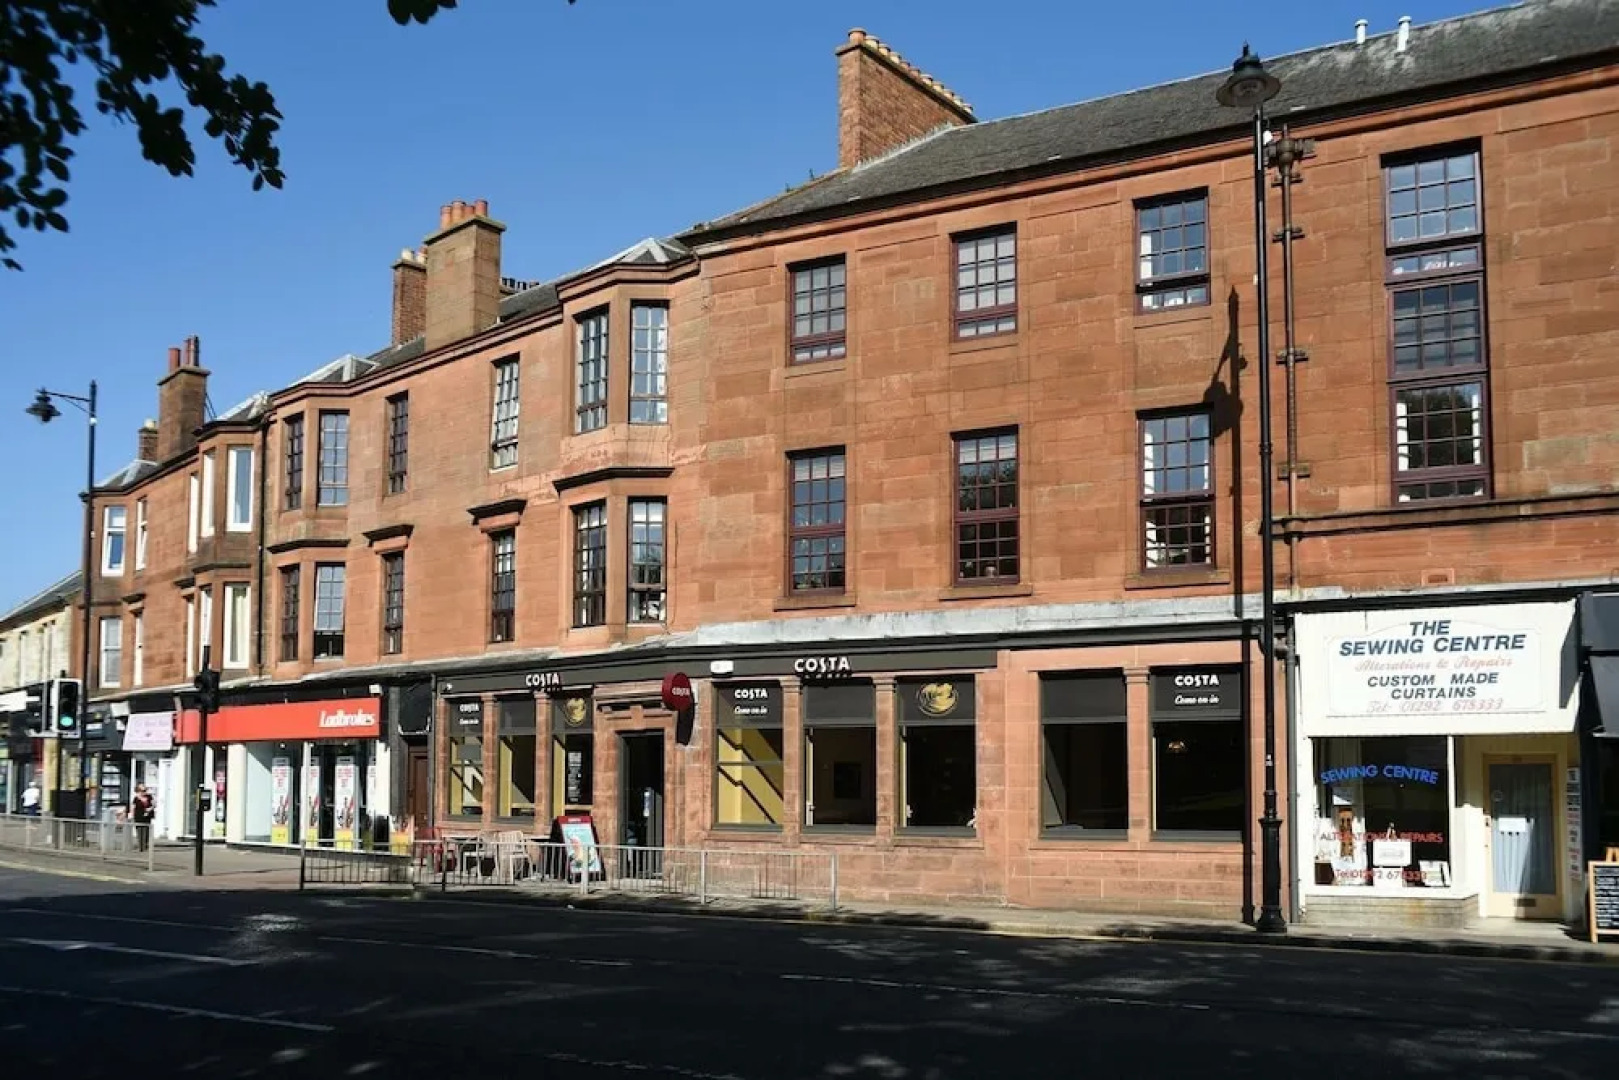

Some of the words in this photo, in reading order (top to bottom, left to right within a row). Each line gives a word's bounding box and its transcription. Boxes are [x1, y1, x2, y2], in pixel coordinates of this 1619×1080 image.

[1410, 620, 1451, 636] THE
[1339, 639, 1424, 656] SEWING
[1433, 634, 1526, 652] CENTRE
[794, 656, 850, 673] COSTA
[1454, 656, 1513, 671] Repairs
[525, 672, 560, 687] COSTA
[1174, 674, 1219, 687] COSTA
[1367, 674, 1435, 687] CUSTOM
[1450, 672, 1499, 685] MADE
[671, 687, 691, 696] COSTA
[734, 688, 768, 699] COSTA
[1391, 686, 1476, 699] CURTAINS
[319, 709, 376, 727] Ladbrokes
[1320, 764, 1378, 785] SEWING
[1383, 765, 1439, 785] CENTRE
[1400, 831, 1444, 843] REPAIRS
